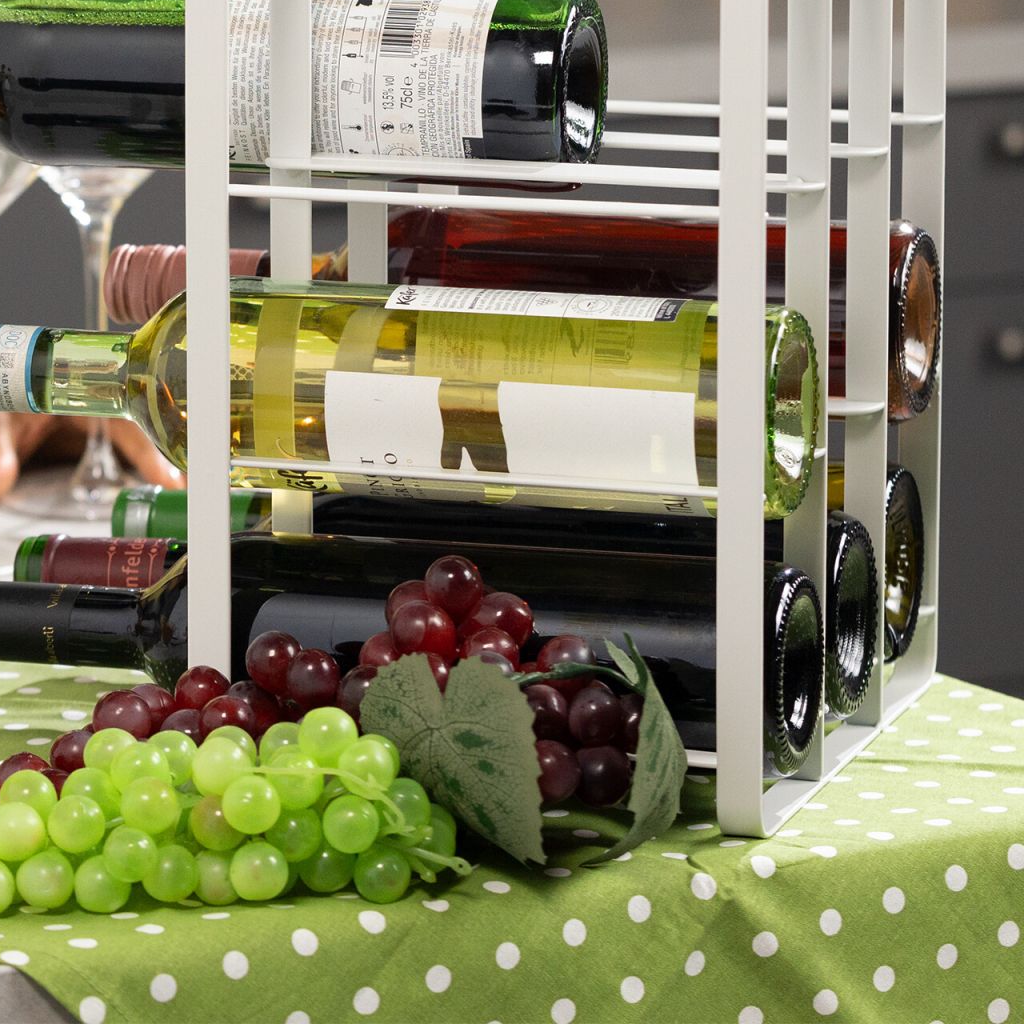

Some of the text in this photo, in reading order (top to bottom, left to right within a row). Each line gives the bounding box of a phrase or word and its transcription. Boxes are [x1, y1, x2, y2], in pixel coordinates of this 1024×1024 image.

[426, 18, 435, 27] DE
[412, 24, 423, 55] 003301
[420, 29, 433, 54] TIERRA
[420, 57, 428, 67] LA
[382, 75, 395, 87] vol
[418, 69, 427, 80] DE
[427, 54, 438, 96] PROTEGIDA
[442, 69, 451, 97] D-54470
[400, 87, 413, 109] 75cl
[417, 82, 427, 101] VINO
[418, 108, 430, 156] TEMPRANILLO
[464, 139, 472, 154] Spain
[5, 331, 22, 346] DOC
[662, 497, 694, 514] ITAL
